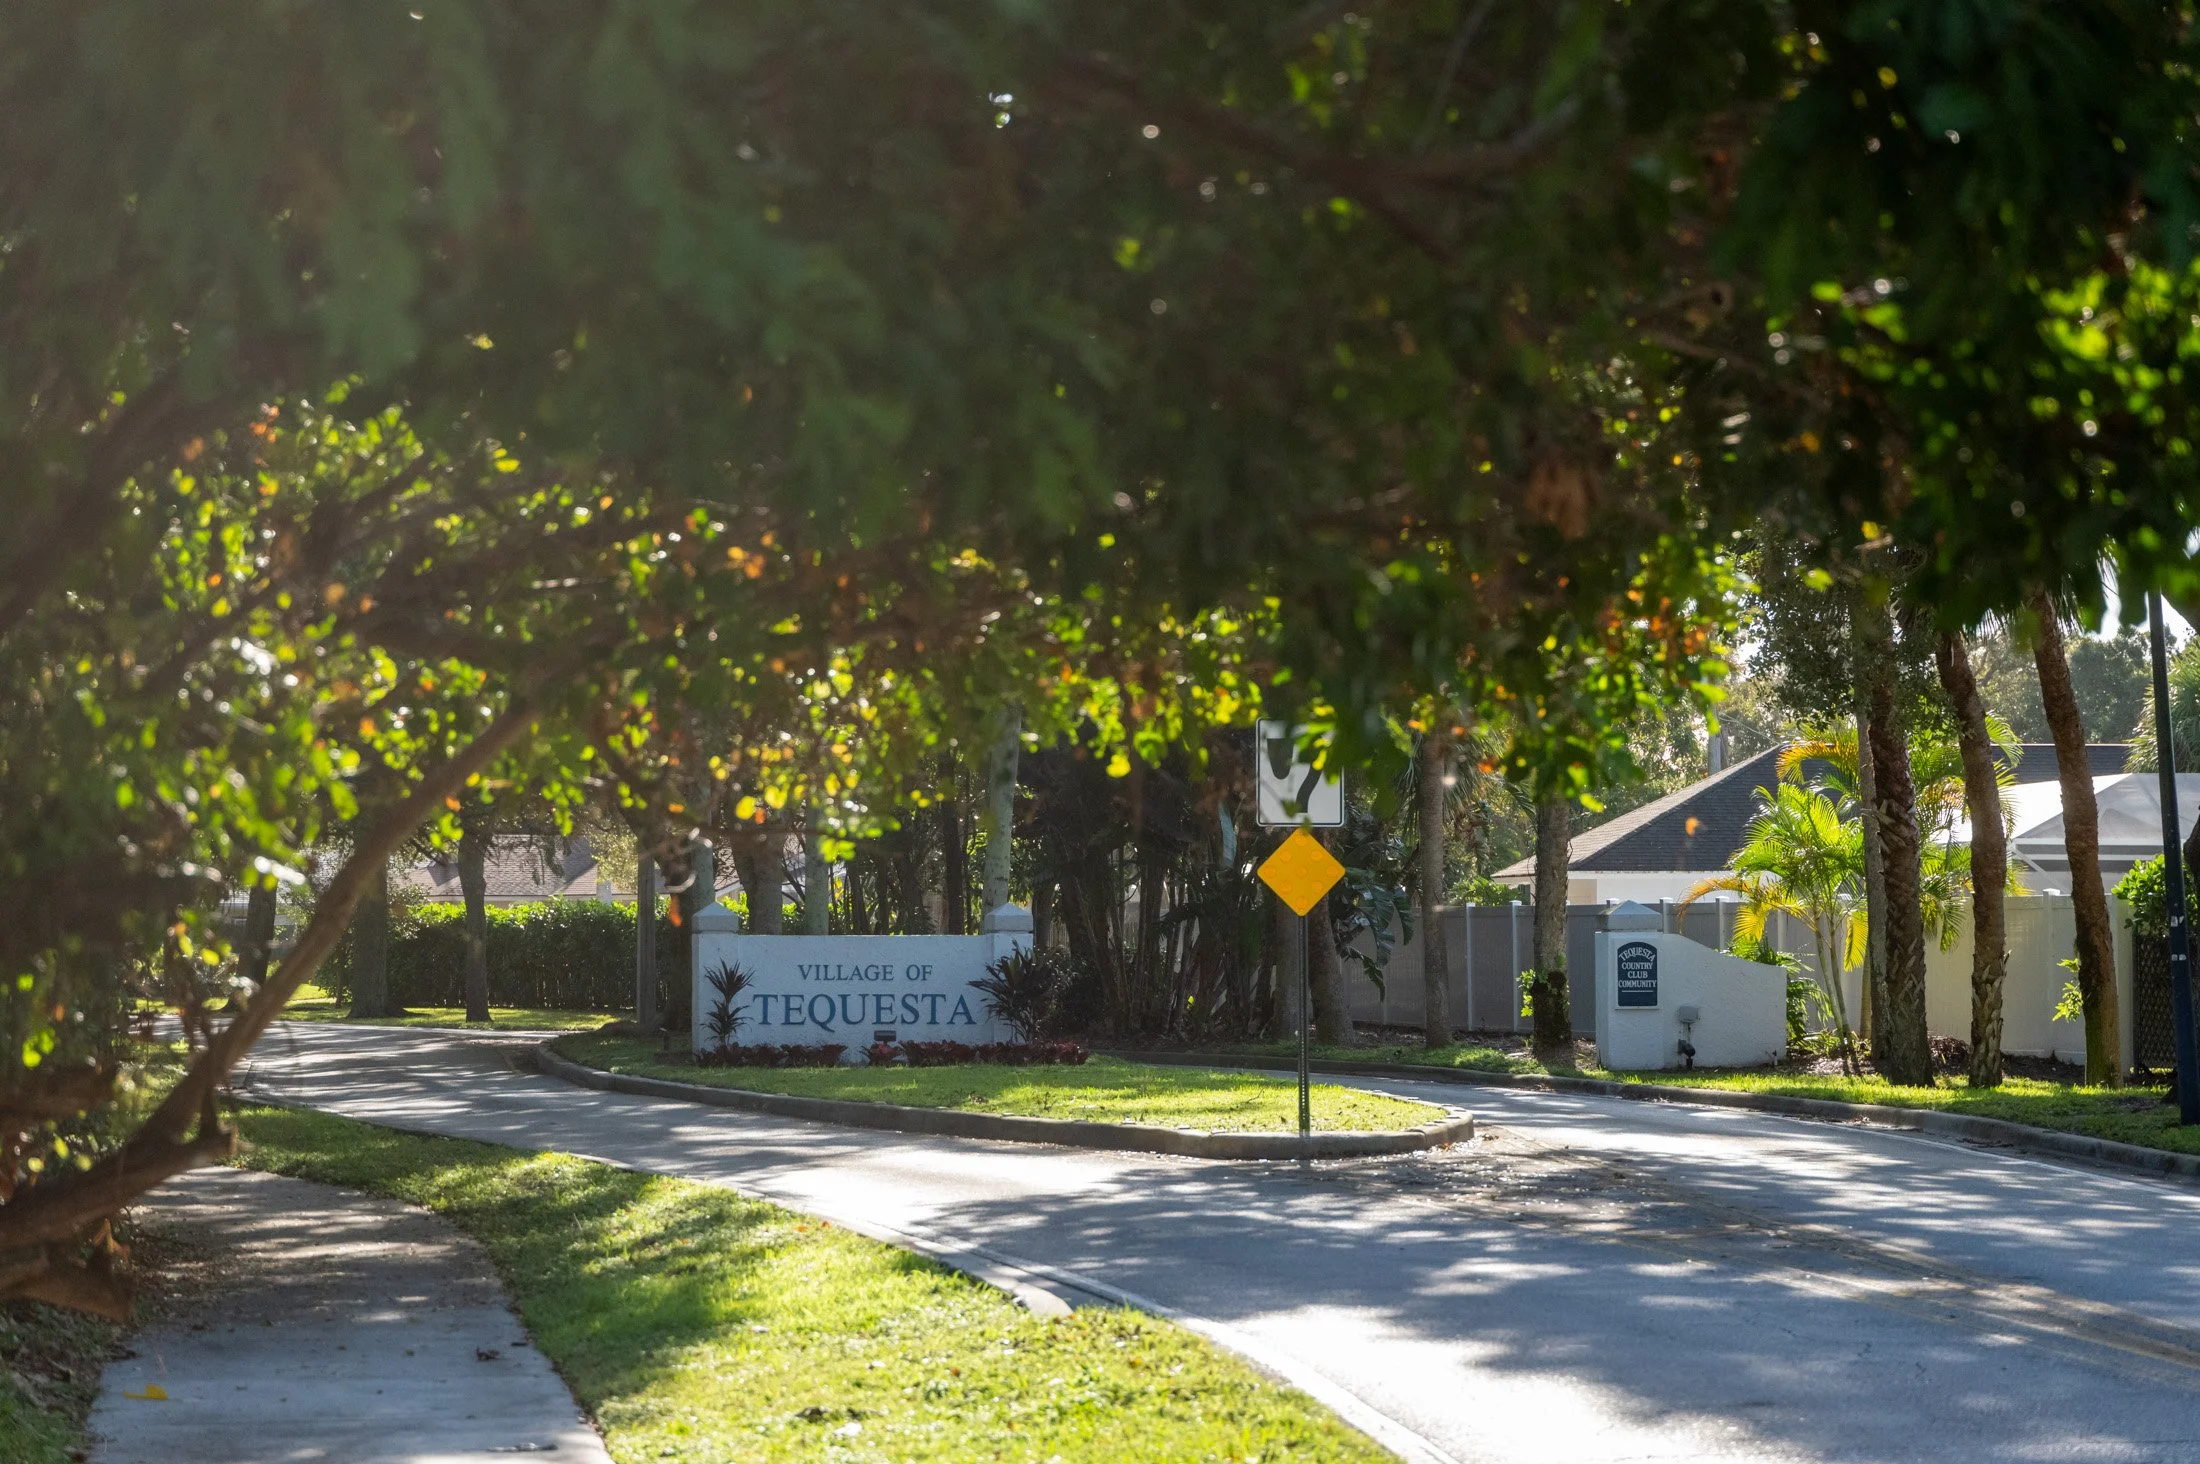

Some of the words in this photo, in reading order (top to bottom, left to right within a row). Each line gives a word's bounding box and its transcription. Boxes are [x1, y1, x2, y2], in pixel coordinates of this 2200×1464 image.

[1619, 947, 1656, 962] TEQUESTA
[797, 963, 894, 981] VILLAGE
[905, 963, 933, 981] OF
[1621, 962, 1653, 970] COUNTRY
[1627, 970, 1648, 979] CLUB
[1618, 979, 1656, 988] COMMUNITY
[752, 992, 977, 1033] TEQUESTA
